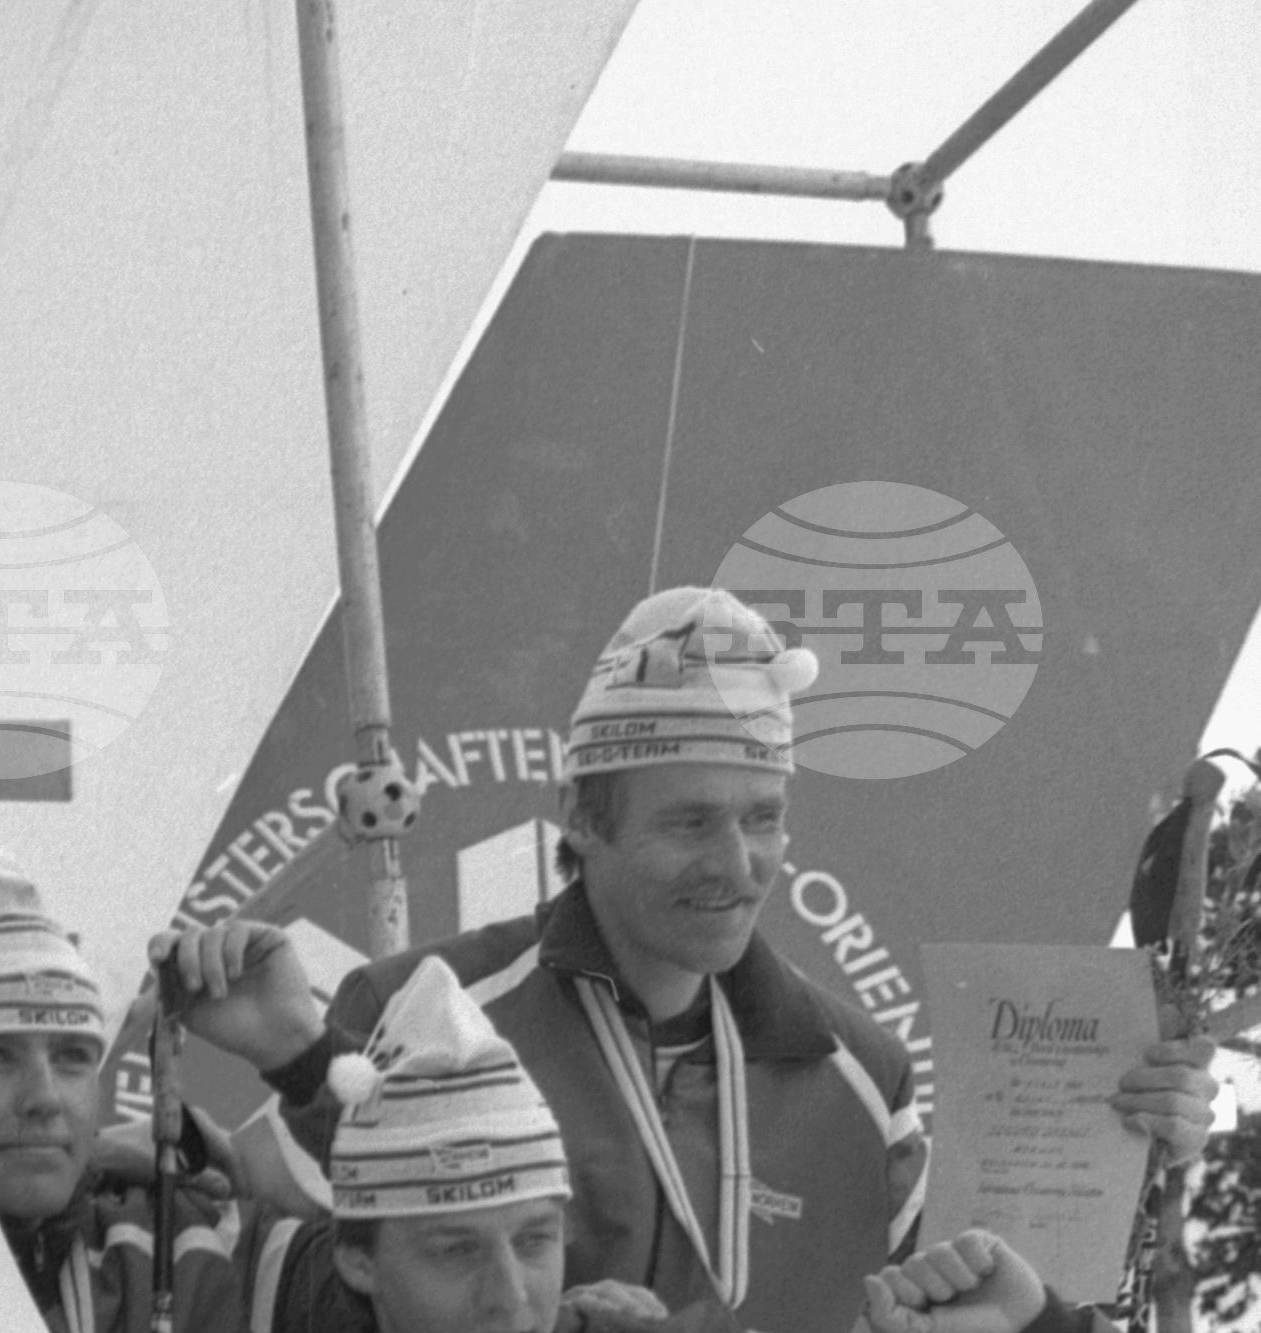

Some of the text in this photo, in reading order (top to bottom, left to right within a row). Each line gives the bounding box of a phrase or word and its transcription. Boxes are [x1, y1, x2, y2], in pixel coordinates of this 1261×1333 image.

[591, 720, 656, 739] SKILOM
[18, 1006, 89, 1025] SKILOM
[990, 998, 1100, 1047] Diploma
[426, 1176, 516, 1204] SKILOM
